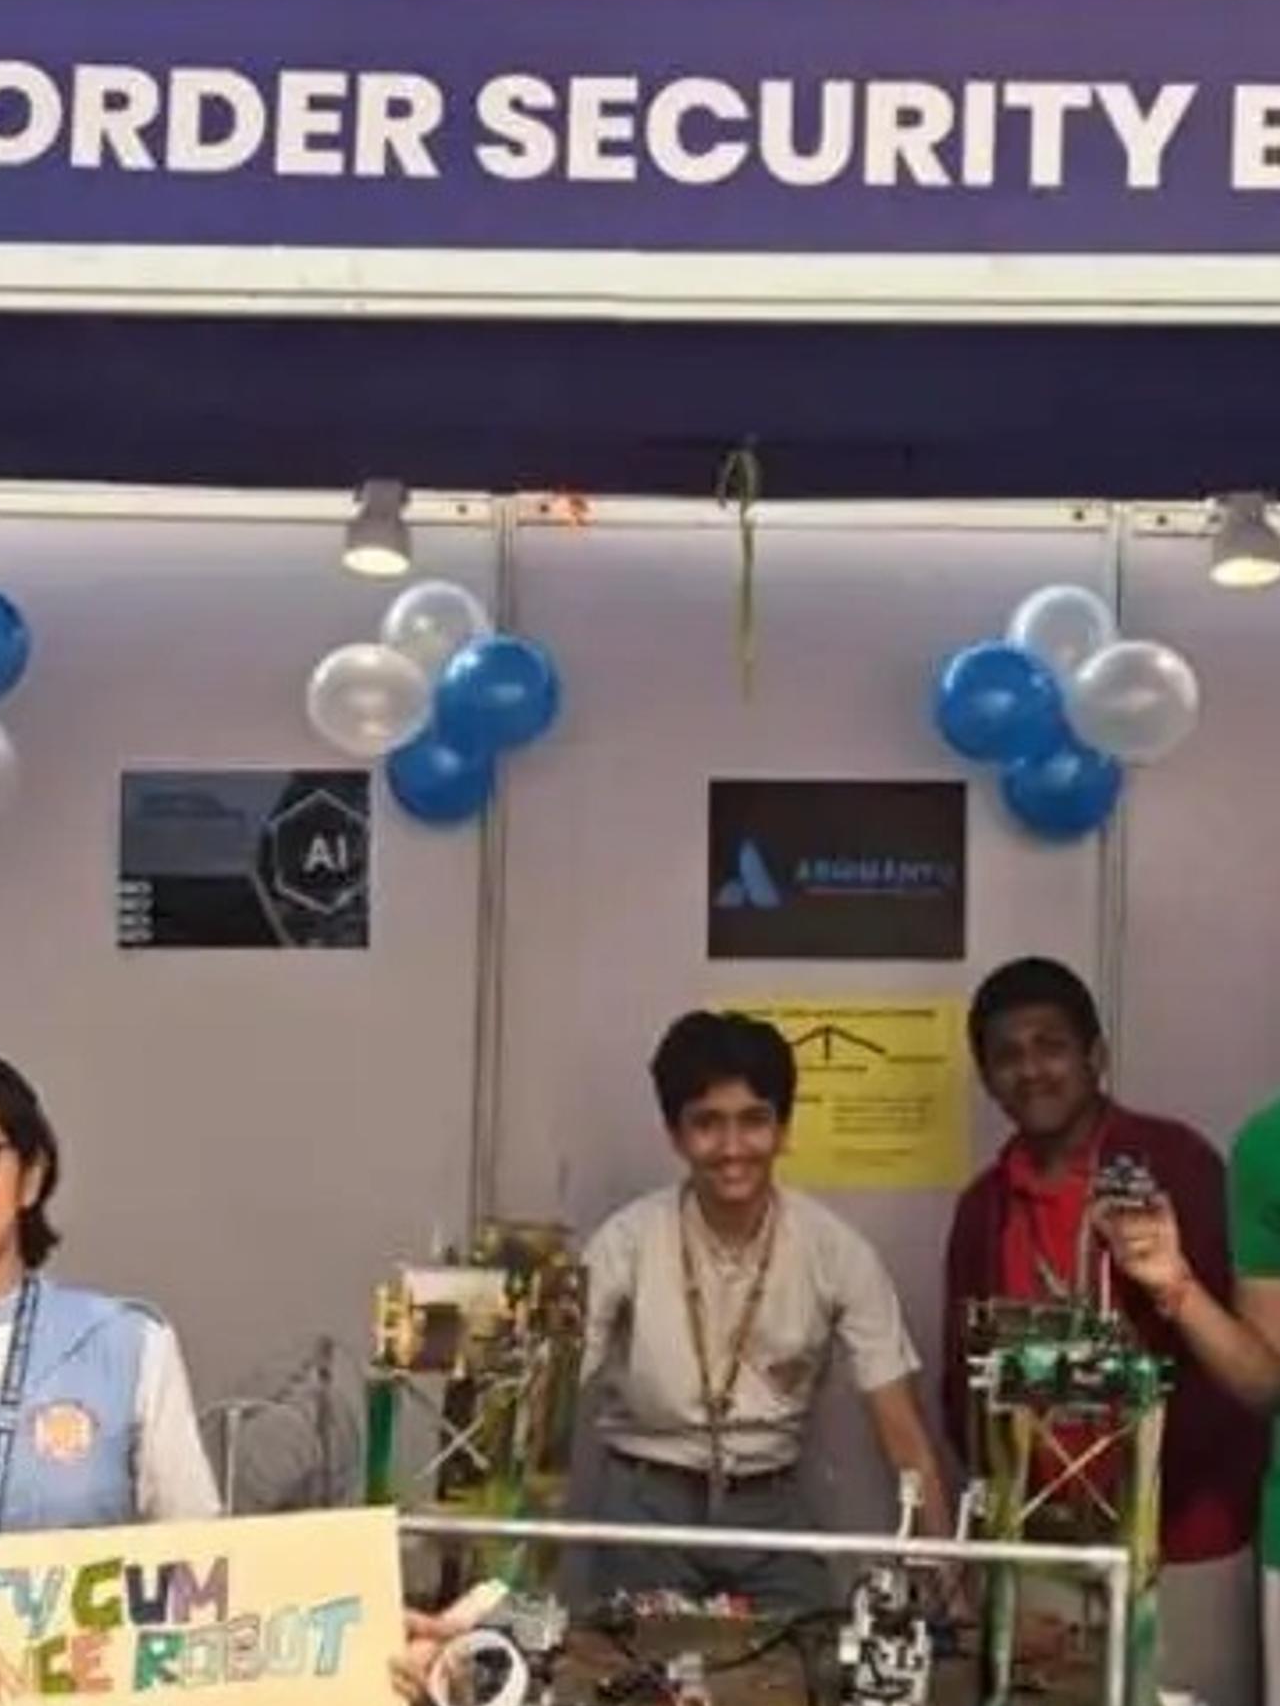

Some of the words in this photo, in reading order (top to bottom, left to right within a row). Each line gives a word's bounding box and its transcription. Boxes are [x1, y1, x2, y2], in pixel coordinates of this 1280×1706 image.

[474, 77, 1197, 188] SECURITY
[302, 834, 348, 872] AI
[134, 1596, 362, 1691] ROBOT
